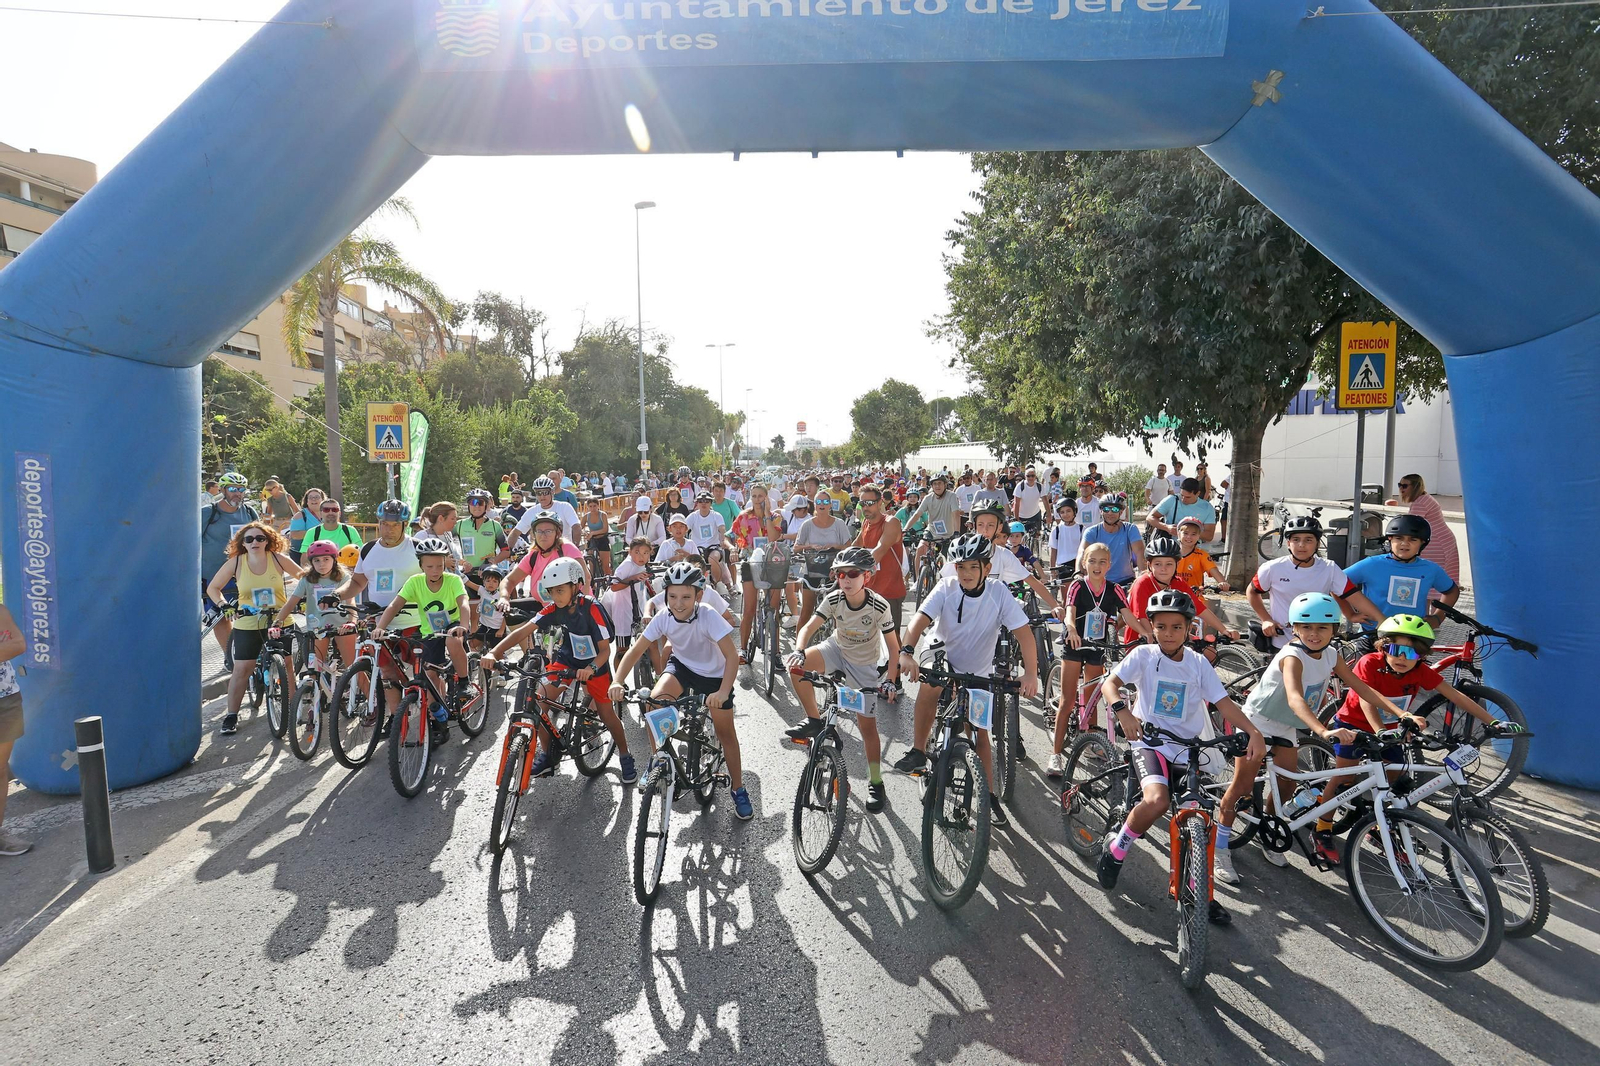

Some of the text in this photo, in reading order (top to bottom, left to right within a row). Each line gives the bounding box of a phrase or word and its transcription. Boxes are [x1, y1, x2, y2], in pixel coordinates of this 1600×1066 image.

[520, 0, 938, 29] Ayuntamiento
[973, 0, 1034, 14] de
[522, 29, 719, 58] Deportes
[1347, 336, 1390, 350] ATENCIÓN
[1345, 393, 1388, 405] PEATONES
[20, 458, 53, 664] deportes@aytojerez.es
[1336, 786, 1361, 802] RIVERSIDE
